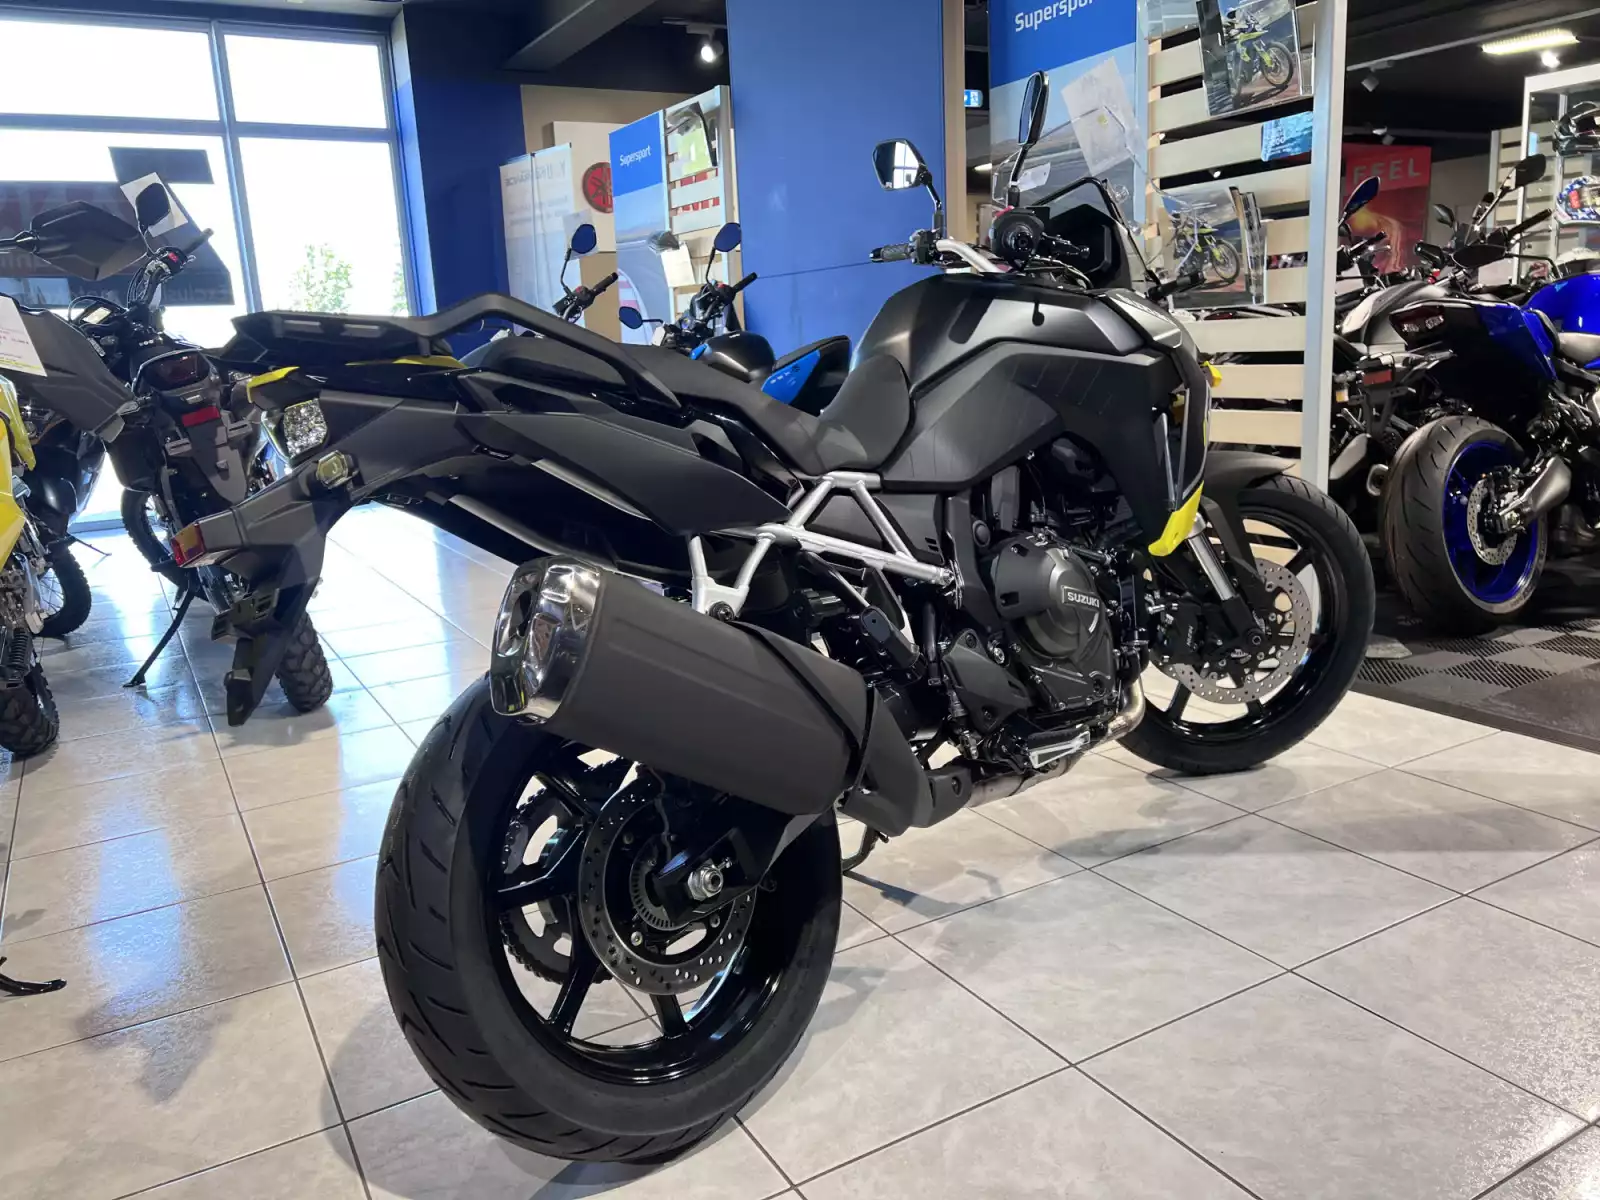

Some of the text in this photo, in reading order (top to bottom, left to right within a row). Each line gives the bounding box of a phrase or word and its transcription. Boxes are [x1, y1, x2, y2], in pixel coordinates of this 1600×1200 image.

[1014, 0, 1093, 32] Superspo
[619, 144, 652, 167] Supersport
[1353, 157, 1422, 185] FEEL
[1067, 591, 1100, 609] SUZUKI
